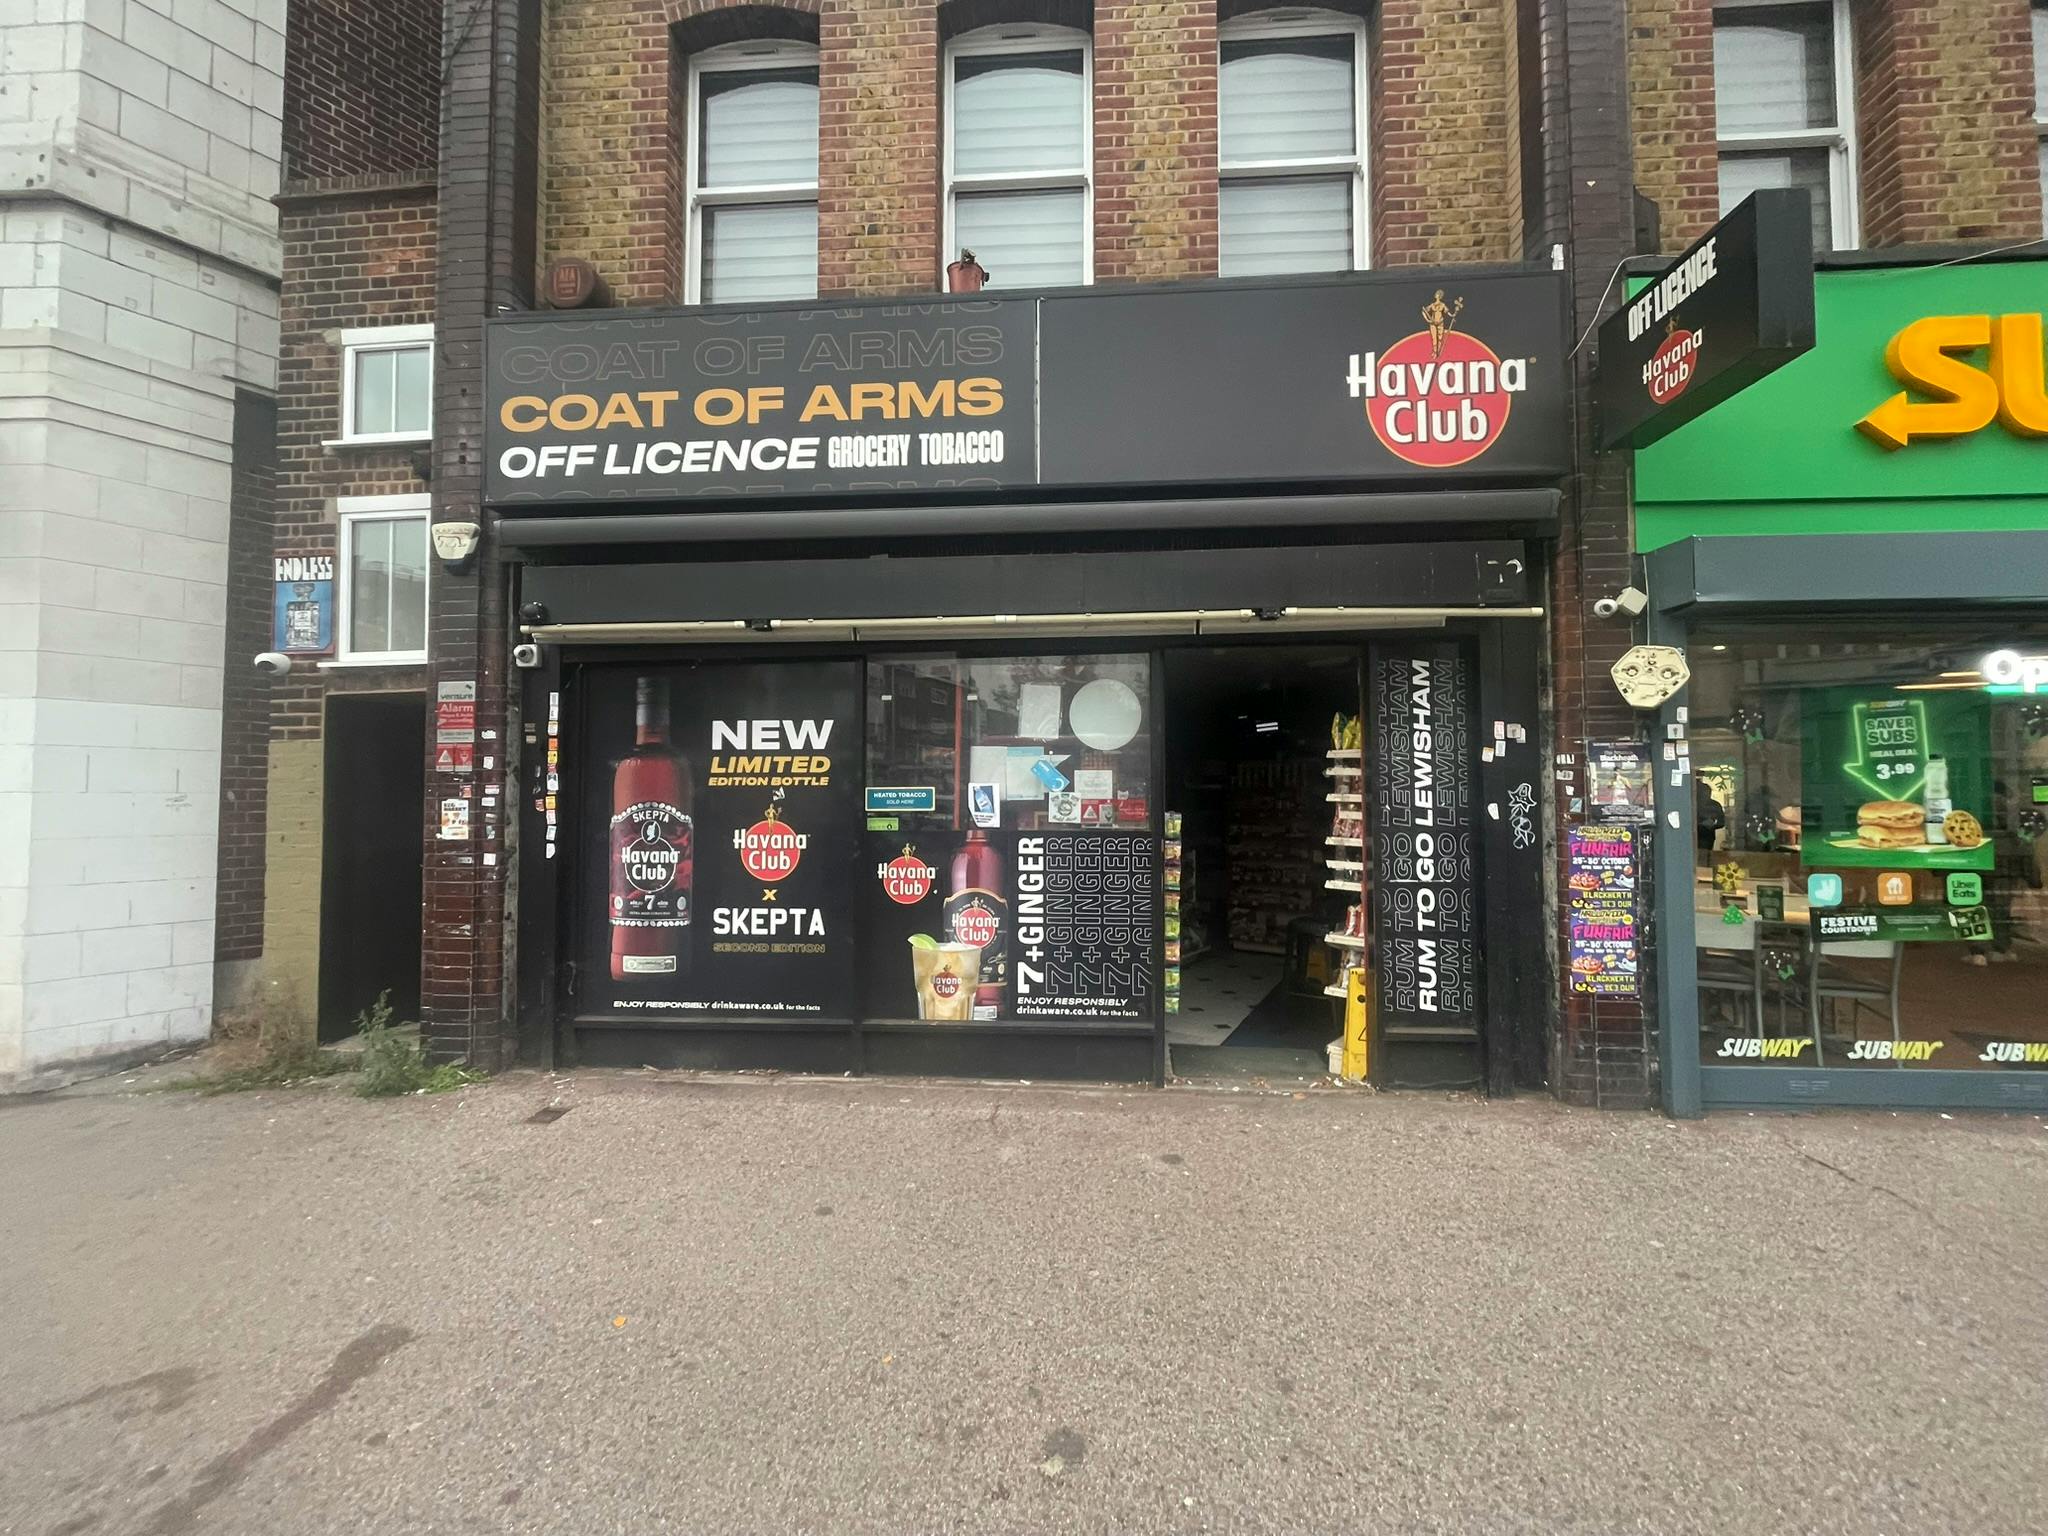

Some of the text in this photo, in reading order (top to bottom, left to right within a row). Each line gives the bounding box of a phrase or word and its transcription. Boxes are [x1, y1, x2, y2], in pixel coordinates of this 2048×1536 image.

[1627, 236, 1718, 342] OFF LICENCE
[501, 325, 1004, 384] COAT OF ARMS
[1642, 328, 1703, 385] Havana
[1346, 352, 1527, 398] Havana
[1654, 361, 1689, 397] Club
[500, 376, 1004, 433] COAT OF ARMS
[1385, 399, 1489, 443] Club
[499, 430, 1004, 479] OFF LICENCE GROCERY TOBACCO
[275, 556, 333, 582] ENDLESS
[440, 703, 474, 713] Alarm
[1866, 717, 1916, 730] SAVER
[711, 719, 834, 751] NEW
[1867, 729, 1917, 745] SUBS
[710, 756, 831, 774] LIMITED
[1876, 763, 1915, 780] 3.99
[708, 776, 830, 786] EDITION BOTTLE
[632, 810, 670, 823] SKEPTA
[733, 829, 807, 850] Havana
[1389, 658, 1416, 1012] RUM TO GO LEWISHAM
[1412, 659, 1438, 1012] RUM TO GO LEWISHAM
[1434, 658, 1460, 1013] RUM TO GO LEWISHAM
[621, 846, 679, 863] Havana
[1571, 842, 1633, 857] FUNFAIR
[748, 850, 791, 870] Club
[631, 864, 667, 880] Club
[877, 862, 936, 879] Havana
[889, 879, 923, 896] Club
[1951, 880, 1976, 889] Uber
[644, 894, 656, 910] 7
[1952, 889, 1977, 898] Eats
[713, 907, 825, 936] SKEPTA
[951, 912, 999, 928] Havana
[1017, 837, 1044, 994] 7+GINGER
[1046, 837, 1073, 995] 7+GINGER
[1074, 837, 1101, 995] 7+GINGER
[1103, 837, 1130, 996] 7+GINGER
[1820, 915, 1877, 928] FESTIVE
[960, 928, 990, 942] Club
[1573, 925, 1634, 940] FUNFAIR
[1820, 926, 1878, 934] COUNTDOWN
[936, 985, 956, 994] Club
[613, 1000, 645, 1008] ENJOY
[645, 1001, 710, 1009] RESPONSIBLY
[711, 1000, 784, 1010] drinkaware.co.uk
[1017, 996, 1128, 1007] ENJOY RESPONSIBLY
[1016, 1005, 1098, 1016] drinkaware.co.uk
[1110, 1009, 1121, 1017] the
[1122, 1009, 1139, 1017] facts
[1716, 1038, 1814, 1058] SUBWAY
[1847, 1040, 1944, 1060] SUBWAY
